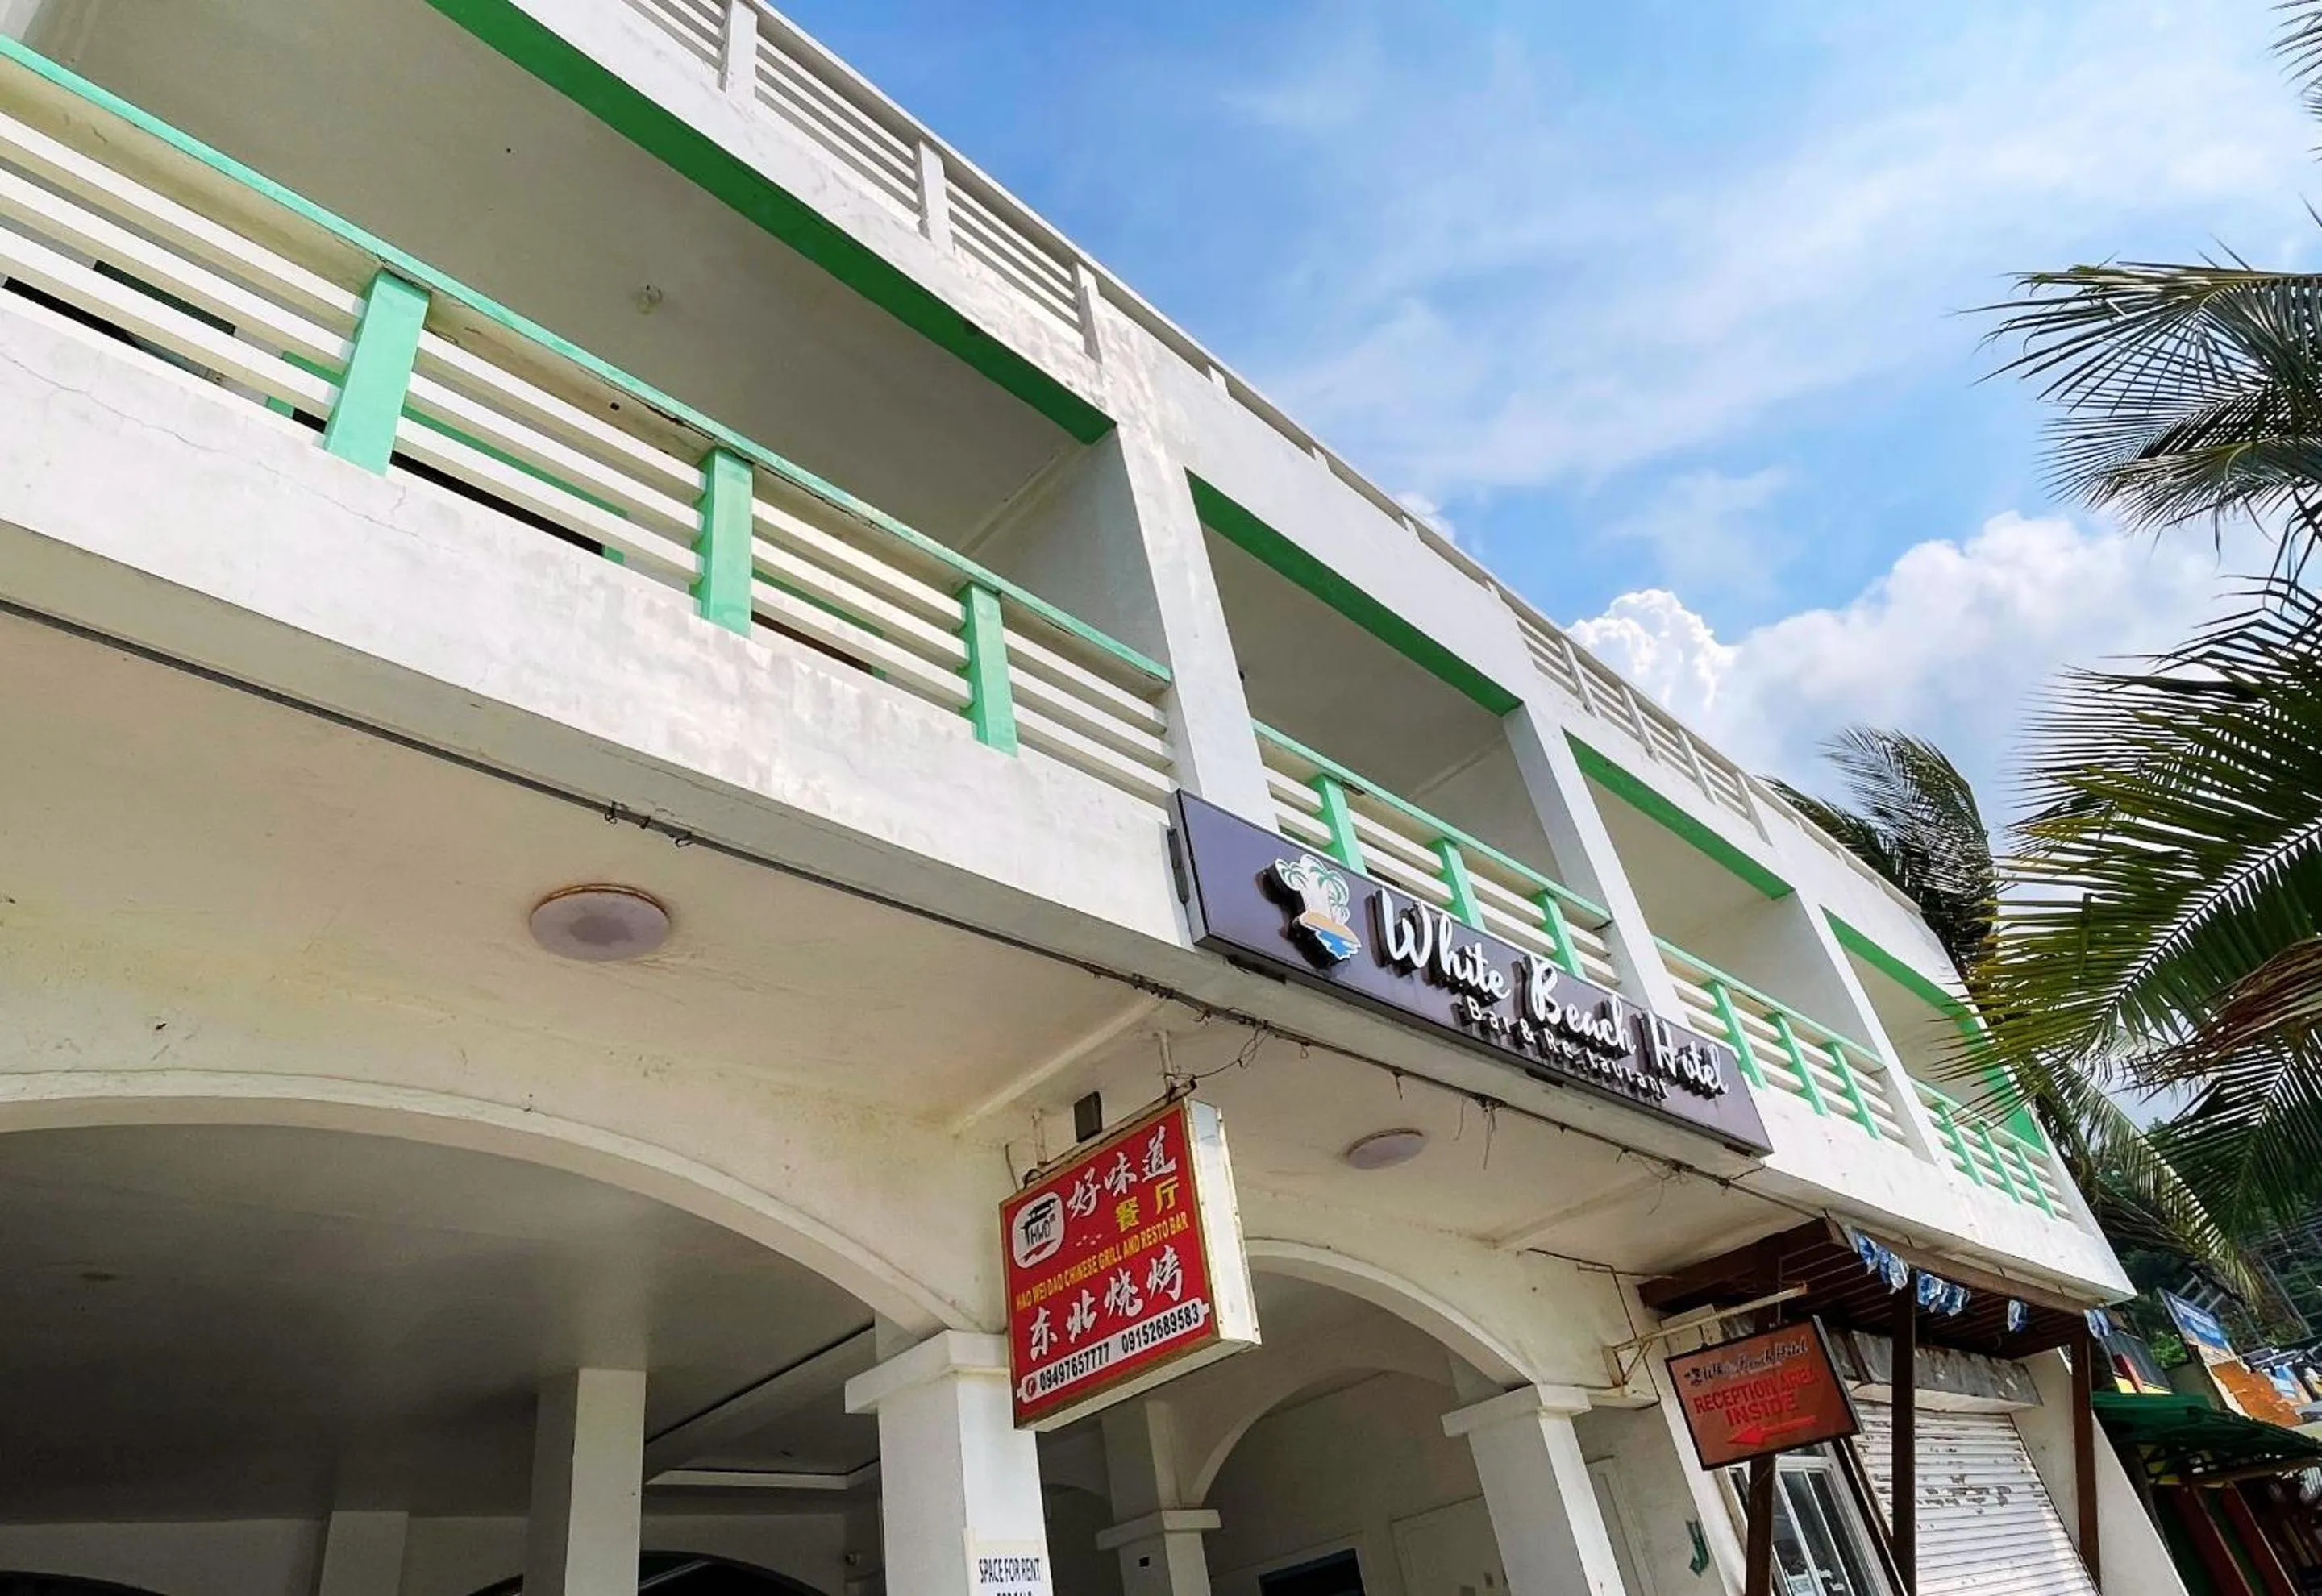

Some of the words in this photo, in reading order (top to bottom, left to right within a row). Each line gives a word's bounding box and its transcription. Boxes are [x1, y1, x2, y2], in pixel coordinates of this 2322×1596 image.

[1382, 887, 1512, 1000] White
[1529, 952, 1637, 1055] Beach
[1648, 1009, 1729, 1094] Hotel
[1467, 996, 1511, 1033] Bar
[1520, 1018, 1536, 1045] &
[1543, 1028, 1670, 1099] Retaurant
[1067, 1126, 1177, 1221] 好味道
[1116, 1176, 1179, 1232] 餐厅
[1016, 1291, 1032, 1311] HAO
[1048, 1273, 1064, 1291] DAO
[1064, 1255, 1098, 1287] CHINESE
[1098, 1244, 1122, 1270] GRILL
[1123, 1235, 1141, 1257] AND
[1142, 1220, 1169, 1250] RESTO
[1170, 1211, 1189, 1236] BAR
[1030, 1244, 1184, 1361] 东北烧烤
[1040, 1343, 1110, 1391] 09497657777
[1121, 1303, 1200, 1354] 09152689583
[1693, 1377, 1778, 1413] RECEPTION
[1725, 1391, 1797, 1427] INSIDE
[979, 1558, 1004, 1583] SPACE
[1005, 1558, 1021, 1583] FOR
[1022, 1558, 1041, 1581] RENT
